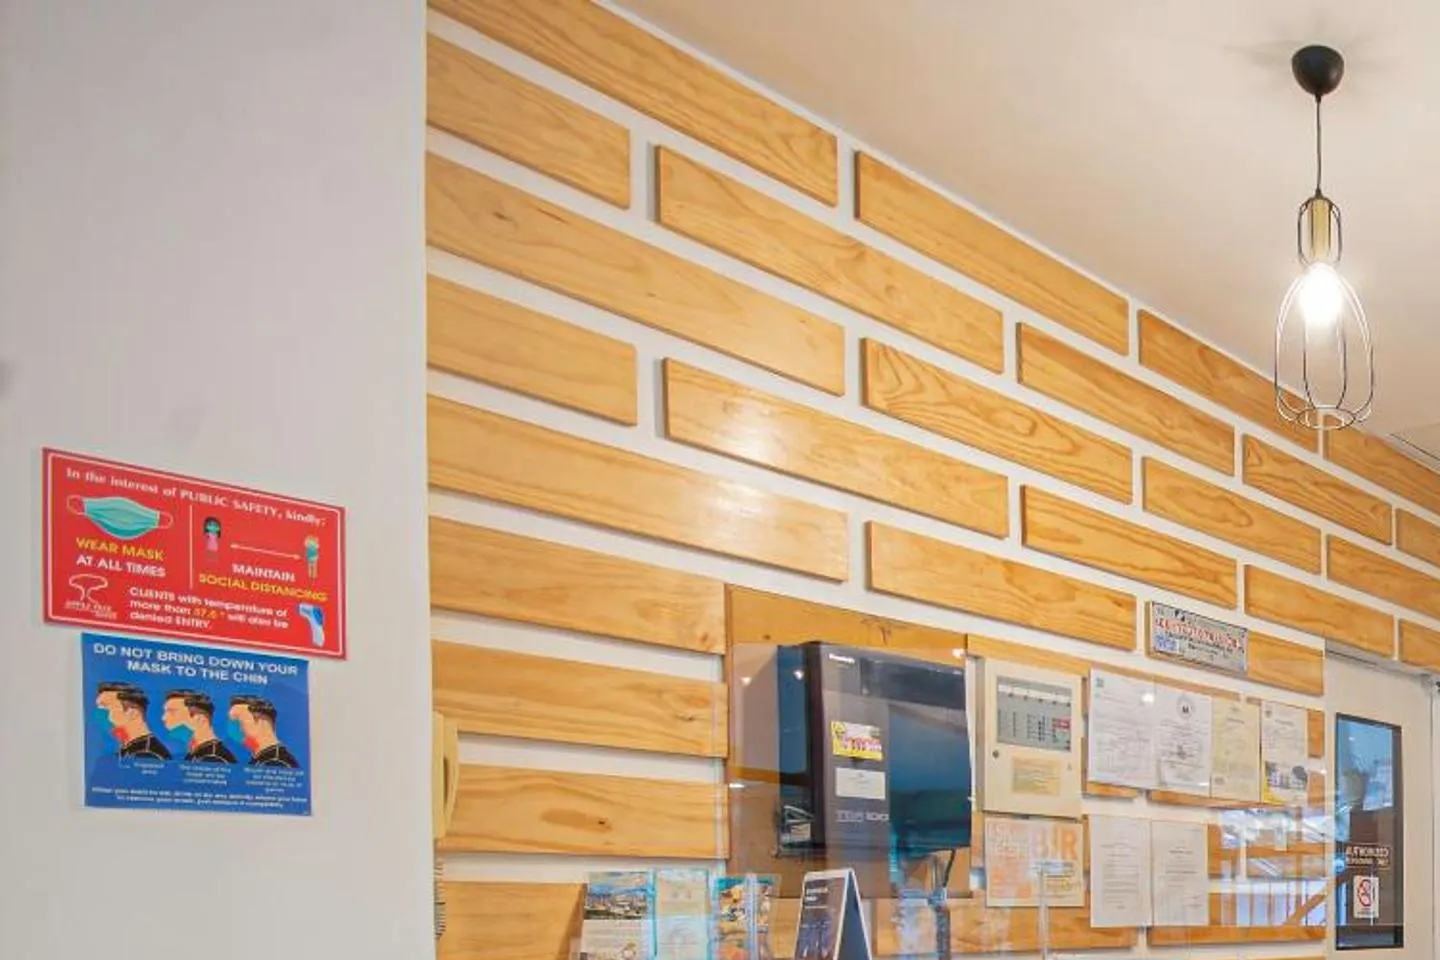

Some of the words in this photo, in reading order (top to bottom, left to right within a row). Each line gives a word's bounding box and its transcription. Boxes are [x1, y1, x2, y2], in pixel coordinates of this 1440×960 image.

[67, 467, 80, 479] In
[86, 471, 106, 483] the
[111, 477, 158, 494] interest
[163, 487, 177, 497] of
[180, 489, 229, 507] PUBLIC
[76, 537, 118, 554] WEAR
[122, 545, 164, 561] MASK
[76, 555, 93, 566] AT
[98, 558, 122, 571] ALL
[125, 562, 166, 578] TIMES
[232, 563, 296, 582] MAINTAIN
[199, 573, 249, 590] SOCIAL
[250, 581, 328, 601] DISTANCING
[129, 586, 175, 601] CLIENTS
[177, 594, 204, 606] with
[205, 599, 273, 616] temperature
[276, 608, 288, 617] of
[130, 600, 161, 612] more
[165, 603, 190, 615] than
[130, 611, 172, 624] denied
[93, 643, 117, 656] DO
[121, 646, 153, 659] NOT
[157, 650, 205, 666] BRING
[208, 655, 255, 671] DOWN
[257, 661, 298, 676] YOUR
[127, 660, 171, 674] MASK
[175, 664, 197, 678] TO
[201, 667, 229, 681] THE
[233, 671, 268, 685] CHIN
